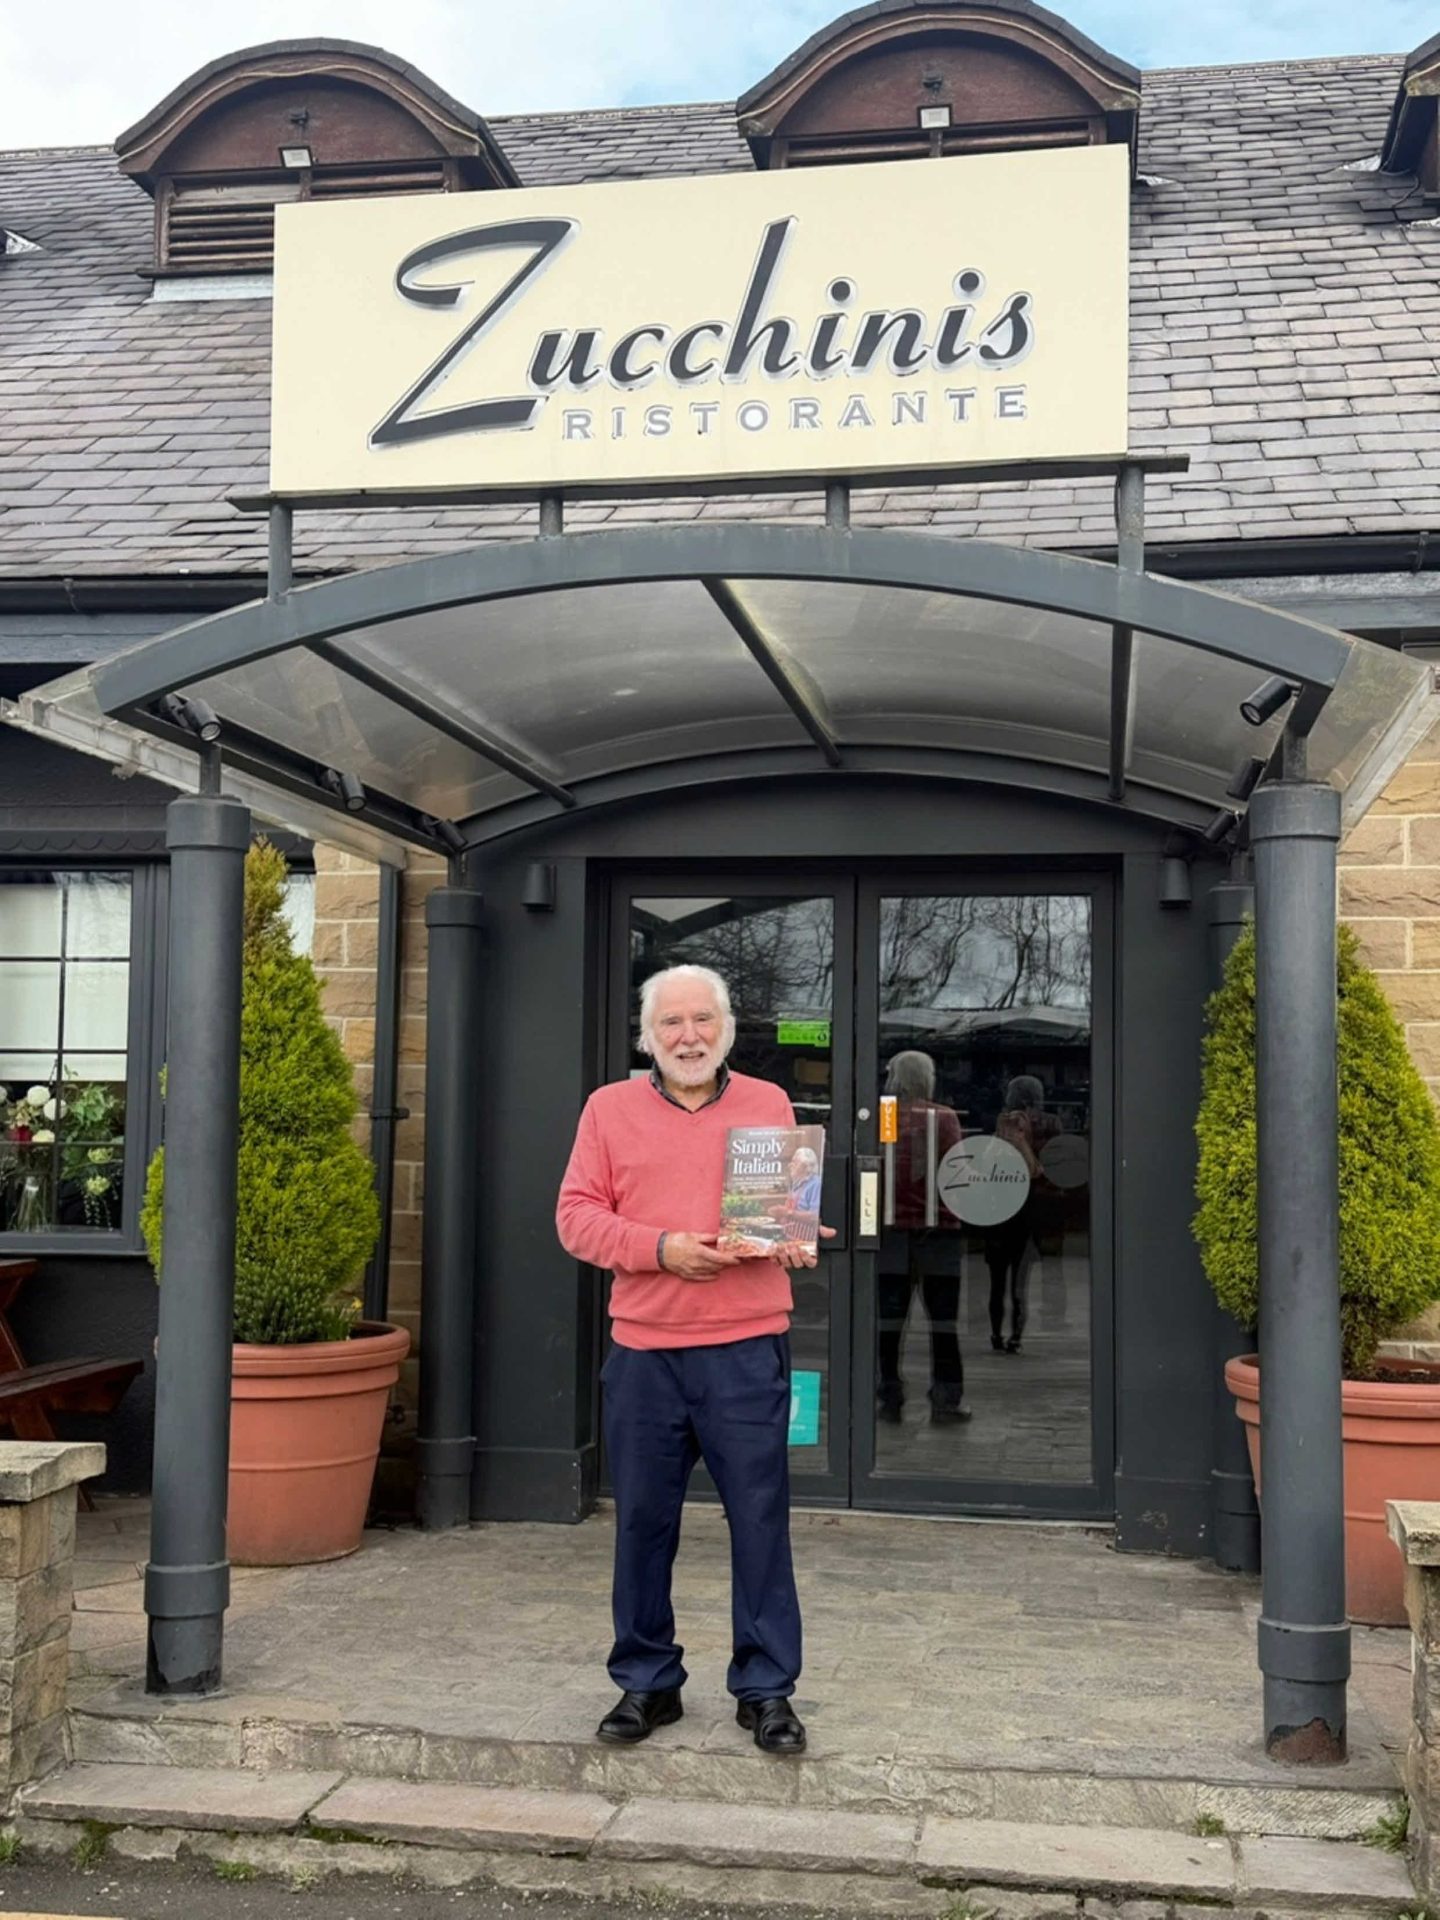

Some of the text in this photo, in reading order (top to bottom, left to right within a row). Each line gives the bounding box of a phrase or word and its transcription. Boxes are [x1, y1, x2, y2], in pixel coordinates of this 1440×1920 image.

[368, 215, 1034, 452] Zucchinis
[562, 385, 1030, 442] RISTORANTE
[731, 1138, 785, 1157] Simply
[733, 1158, 782, 1174] Italian
